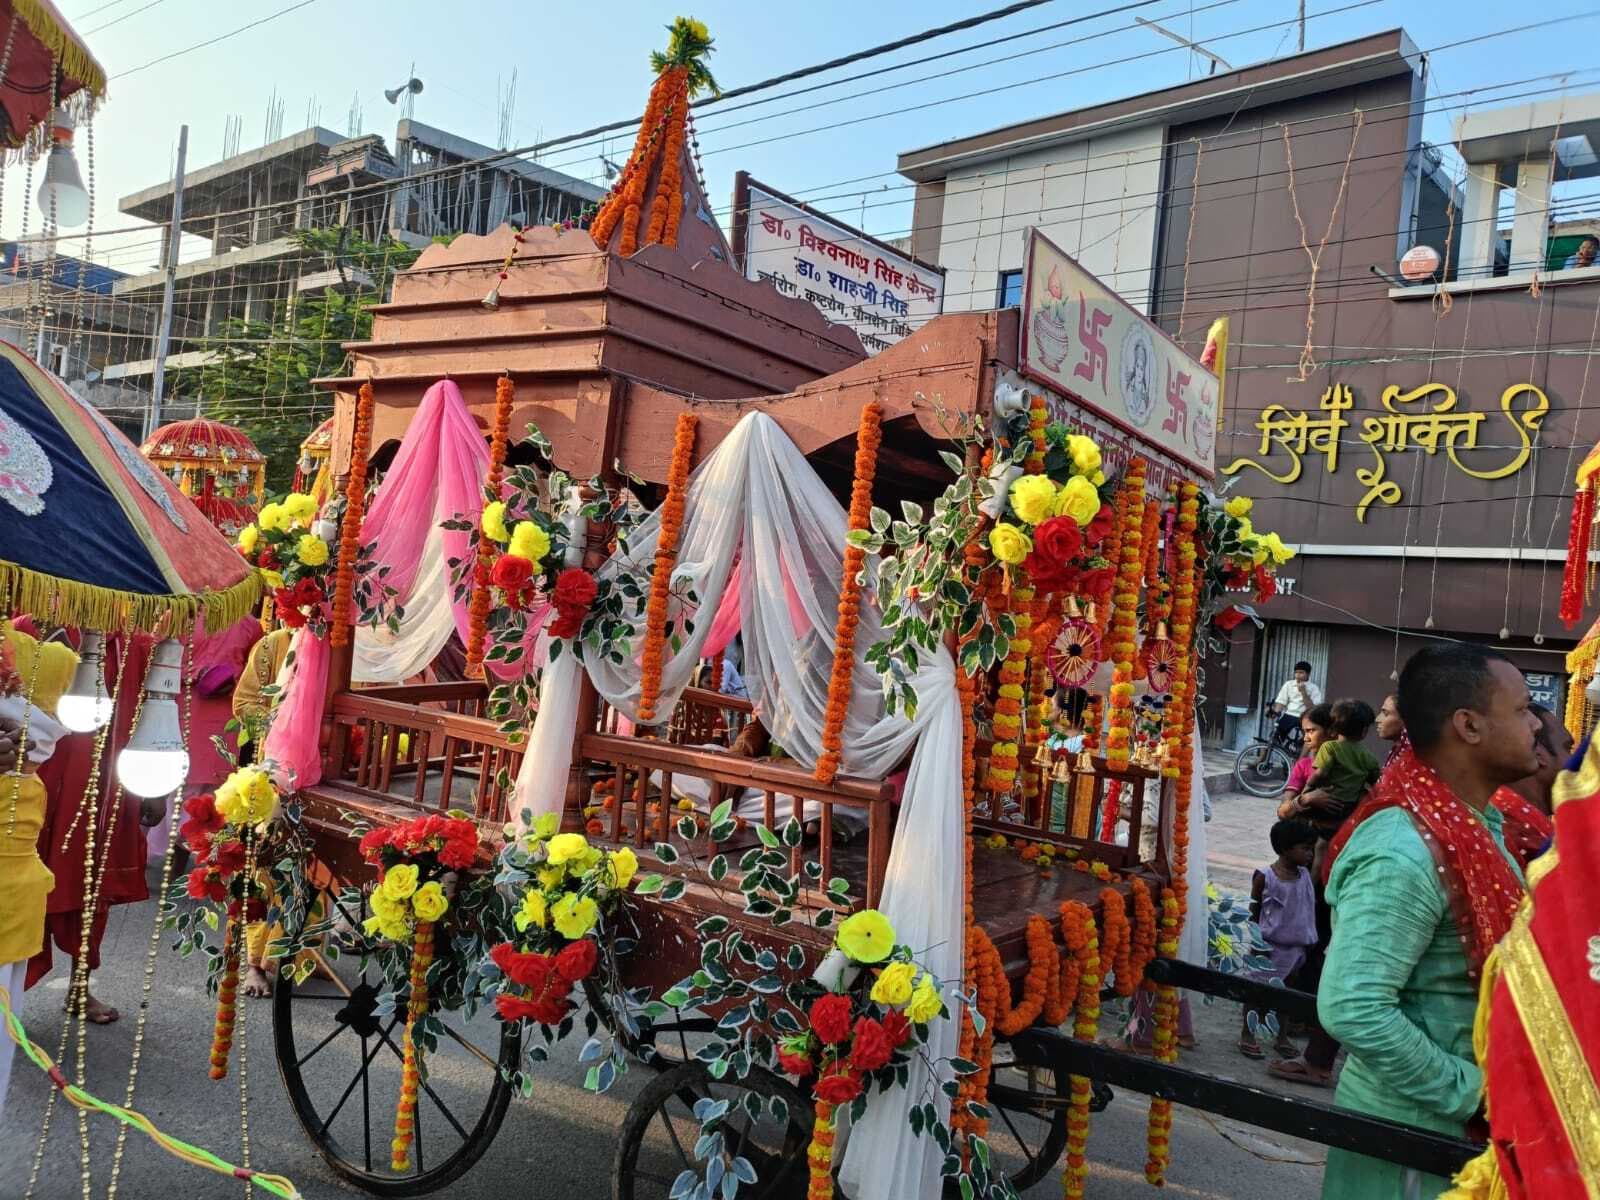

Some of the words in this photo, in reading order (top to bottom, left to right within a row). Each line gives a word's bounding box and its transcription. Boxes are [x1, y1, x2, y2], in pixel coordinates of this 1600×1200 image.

[798, 224, 869, 274] विश्वनाथ
[874, 257, 903, 289] सिंह
[1220, 383, 1353, 484] शिव
[1355, 383, 1550, 524] शक्ति
